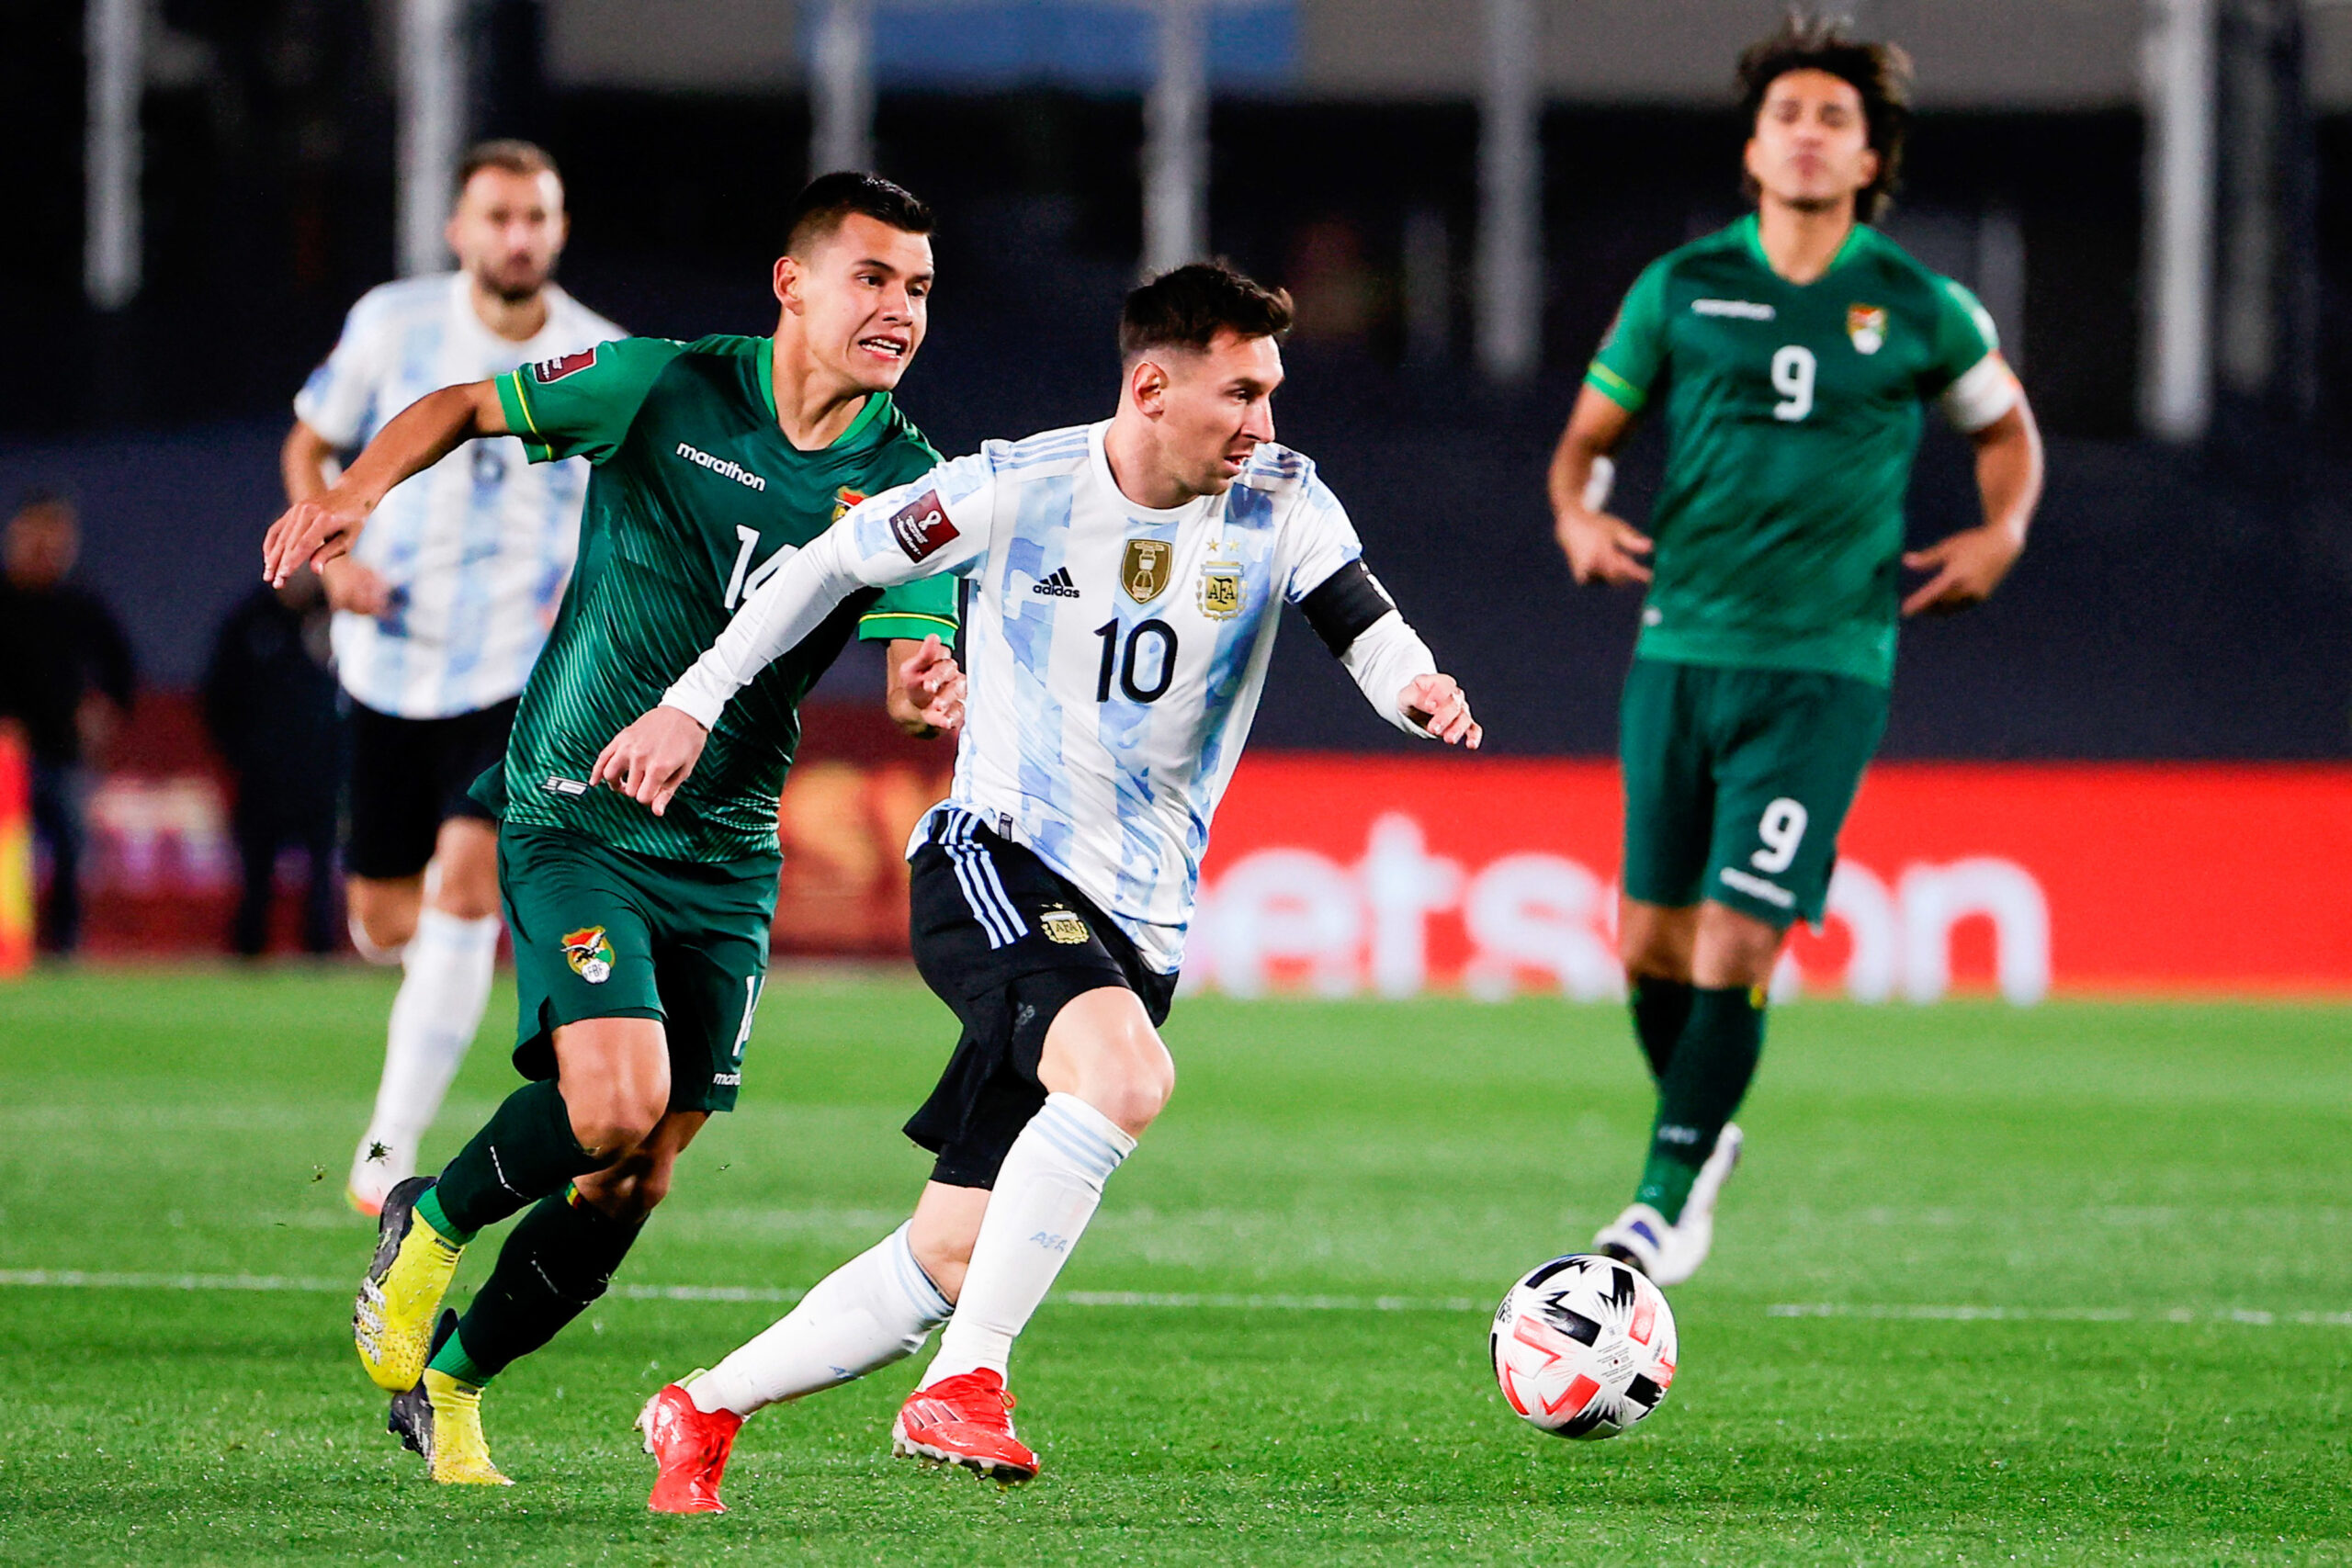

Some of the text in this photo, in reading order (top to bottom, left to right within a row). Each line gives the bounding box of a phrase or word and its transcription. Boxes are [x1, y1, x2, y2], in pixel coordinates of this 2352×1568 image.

[1770, 345, 1818, 423] 9
[676, 440, 766, 493] marathon
[1033, 584, 1080, 599] adidas
[1207, 576, 1236, 604] AFA
[1093, 617, 1179, 704] 10
[1750, 796, 1809, 874] 9
[1180, 811, 2050, 1000] etson
[1029, 1231, 1069, 1254] AFA
